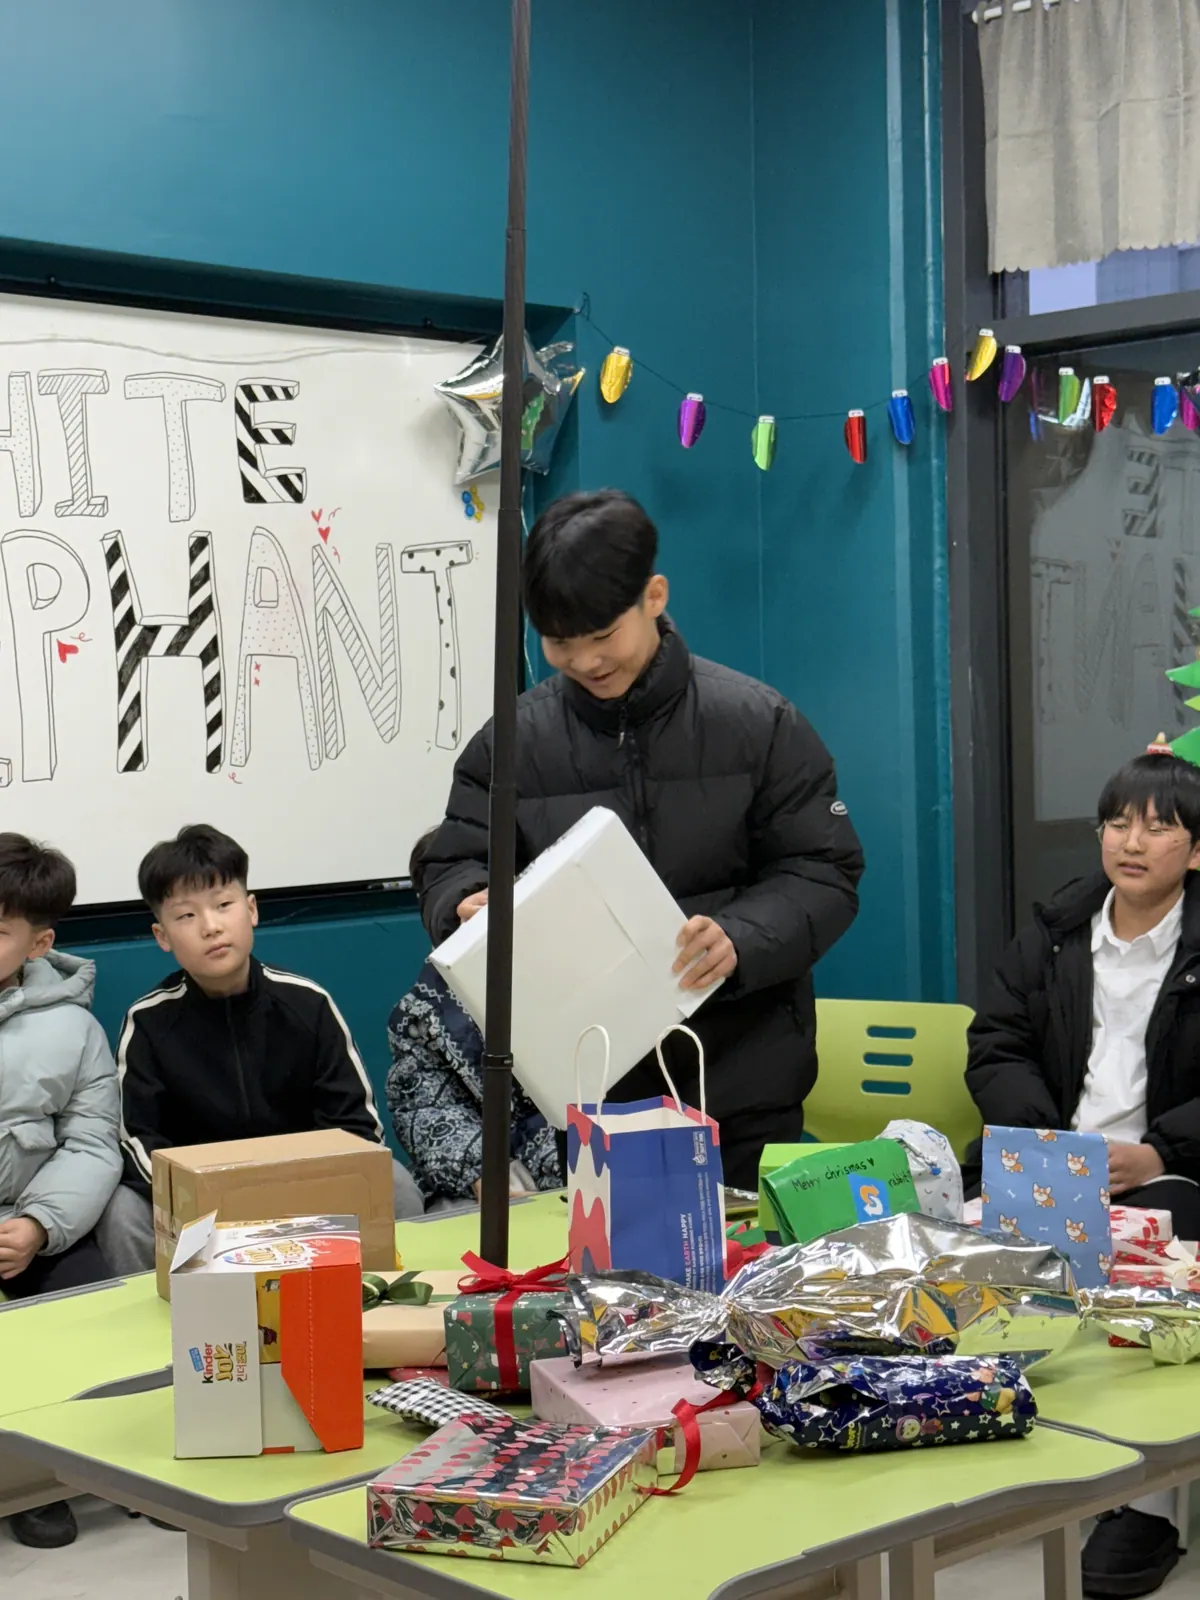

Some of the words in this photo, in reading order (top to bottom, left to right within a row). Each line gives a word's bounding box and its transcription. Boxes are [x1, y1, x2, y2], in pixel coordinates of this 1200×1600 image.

[0, 526, 472, 788] PHANT
[791, 1176, 820, 1192] Merry
[680, 1213, 689, 1239] HAPPY
[683, 1241, 691, 1266] EARTH
[202, 1342, 214, 1384] Kinder
[214, 1344, 233, 1382] JOY
